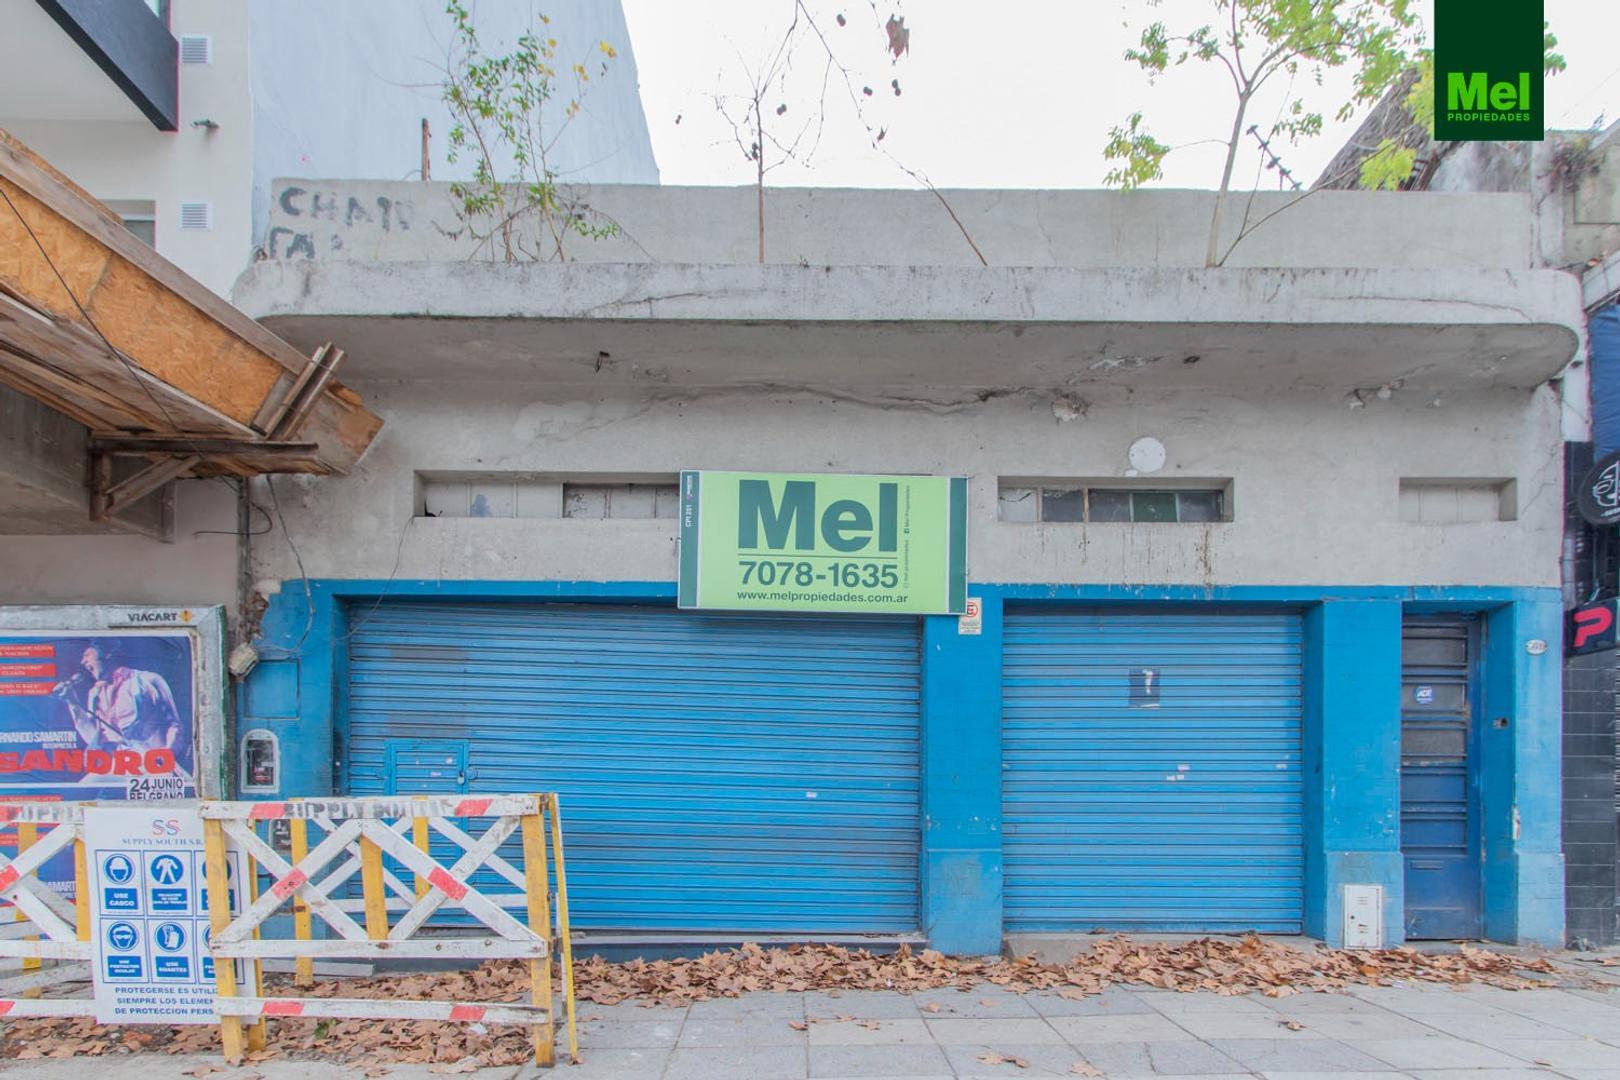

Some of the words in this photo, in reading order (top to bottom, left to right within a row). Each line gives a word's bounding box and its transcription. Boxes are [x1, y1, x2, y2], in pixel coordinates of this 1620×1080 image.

[738, 479, 898, 553] Mel
[738, 561, 899, 589] 7078-1635
[737, 590, 908, 603] www.melpropiedades.com.ar
[128, 613, 178, 622] VIACART
[0, 748, 175, 776] SANDRO
[129, 778, 149, 793] 24
[151, 778, 183, 790] JUNIO
[122, 838, 153, 846] SUPPLY
[115, 986, 176, 994] PROTEGERSE
[117, 997, 157, 1005] SIEMPRE
[115, 1007, 127, 1015] DE
[129, 1007, 188, 1015] PROTECCION
